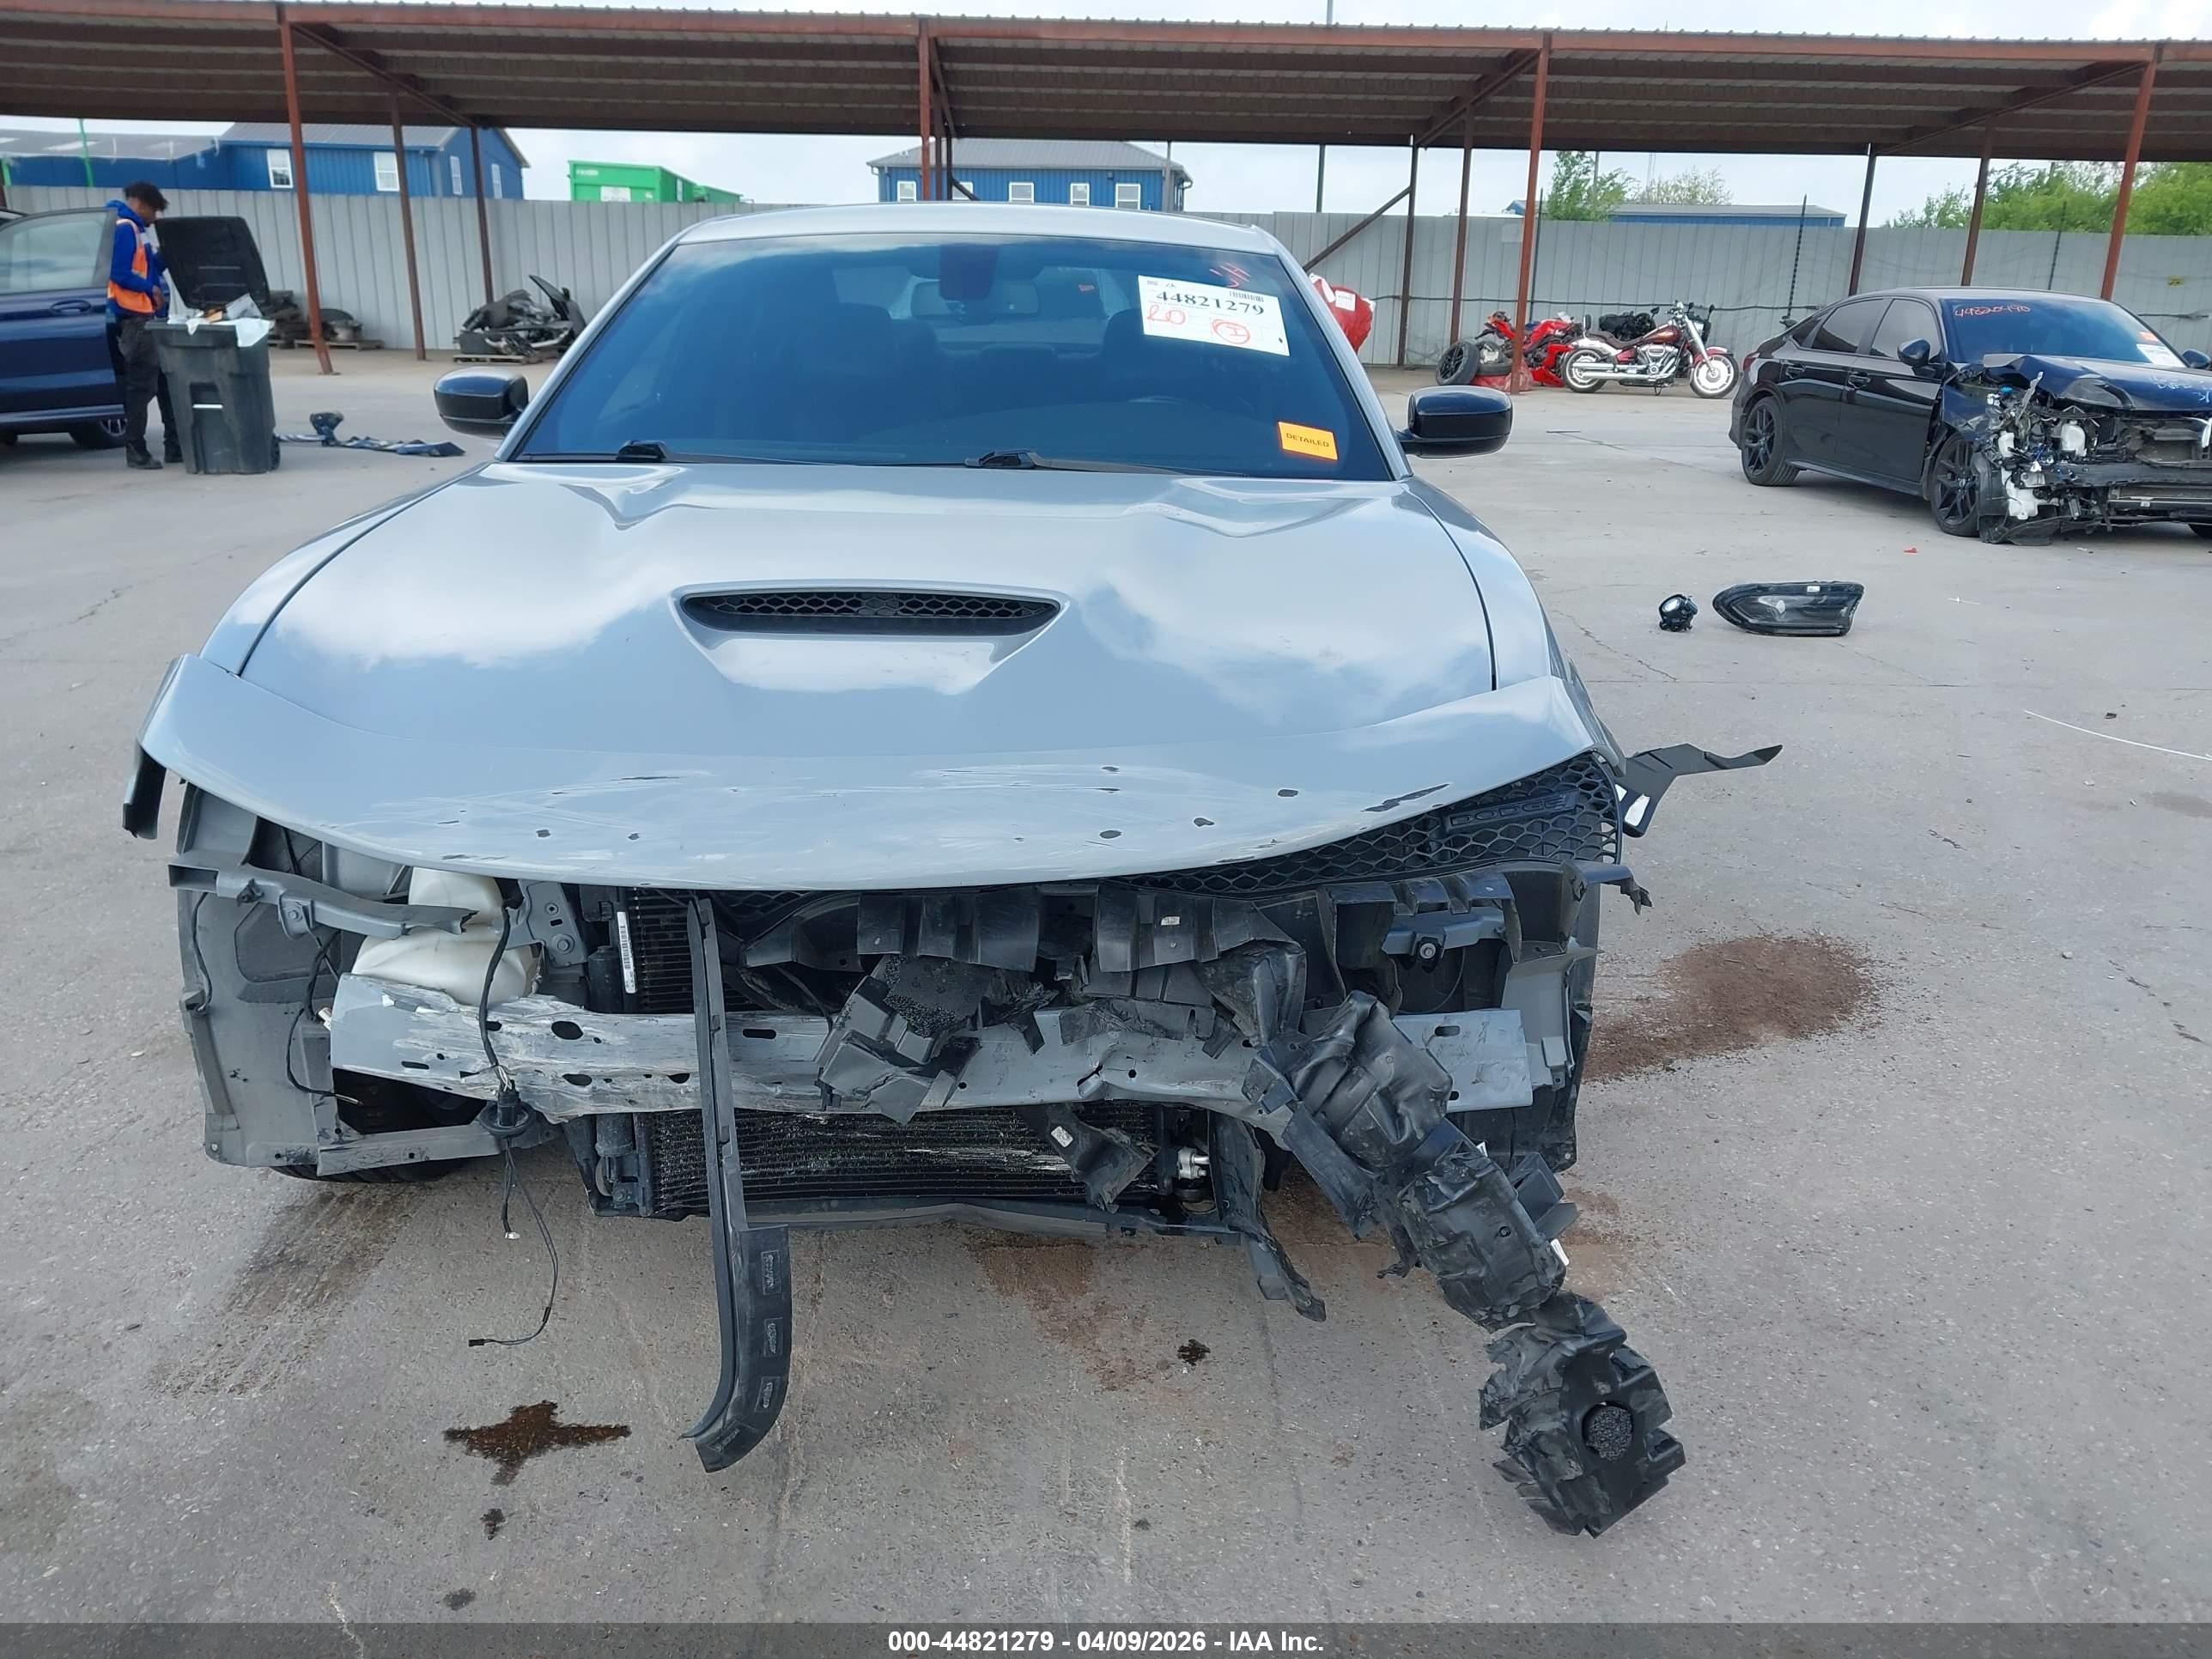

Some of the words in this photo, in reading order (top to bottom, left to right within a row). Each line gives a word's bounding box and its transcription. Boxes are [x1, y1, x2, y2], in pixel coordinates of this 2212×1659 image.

[1156, 291, 1265, 315] 44821279
[1285, 433, 1330, 447] DETAILED
[1449, 793, 1566, 827] DODGE
